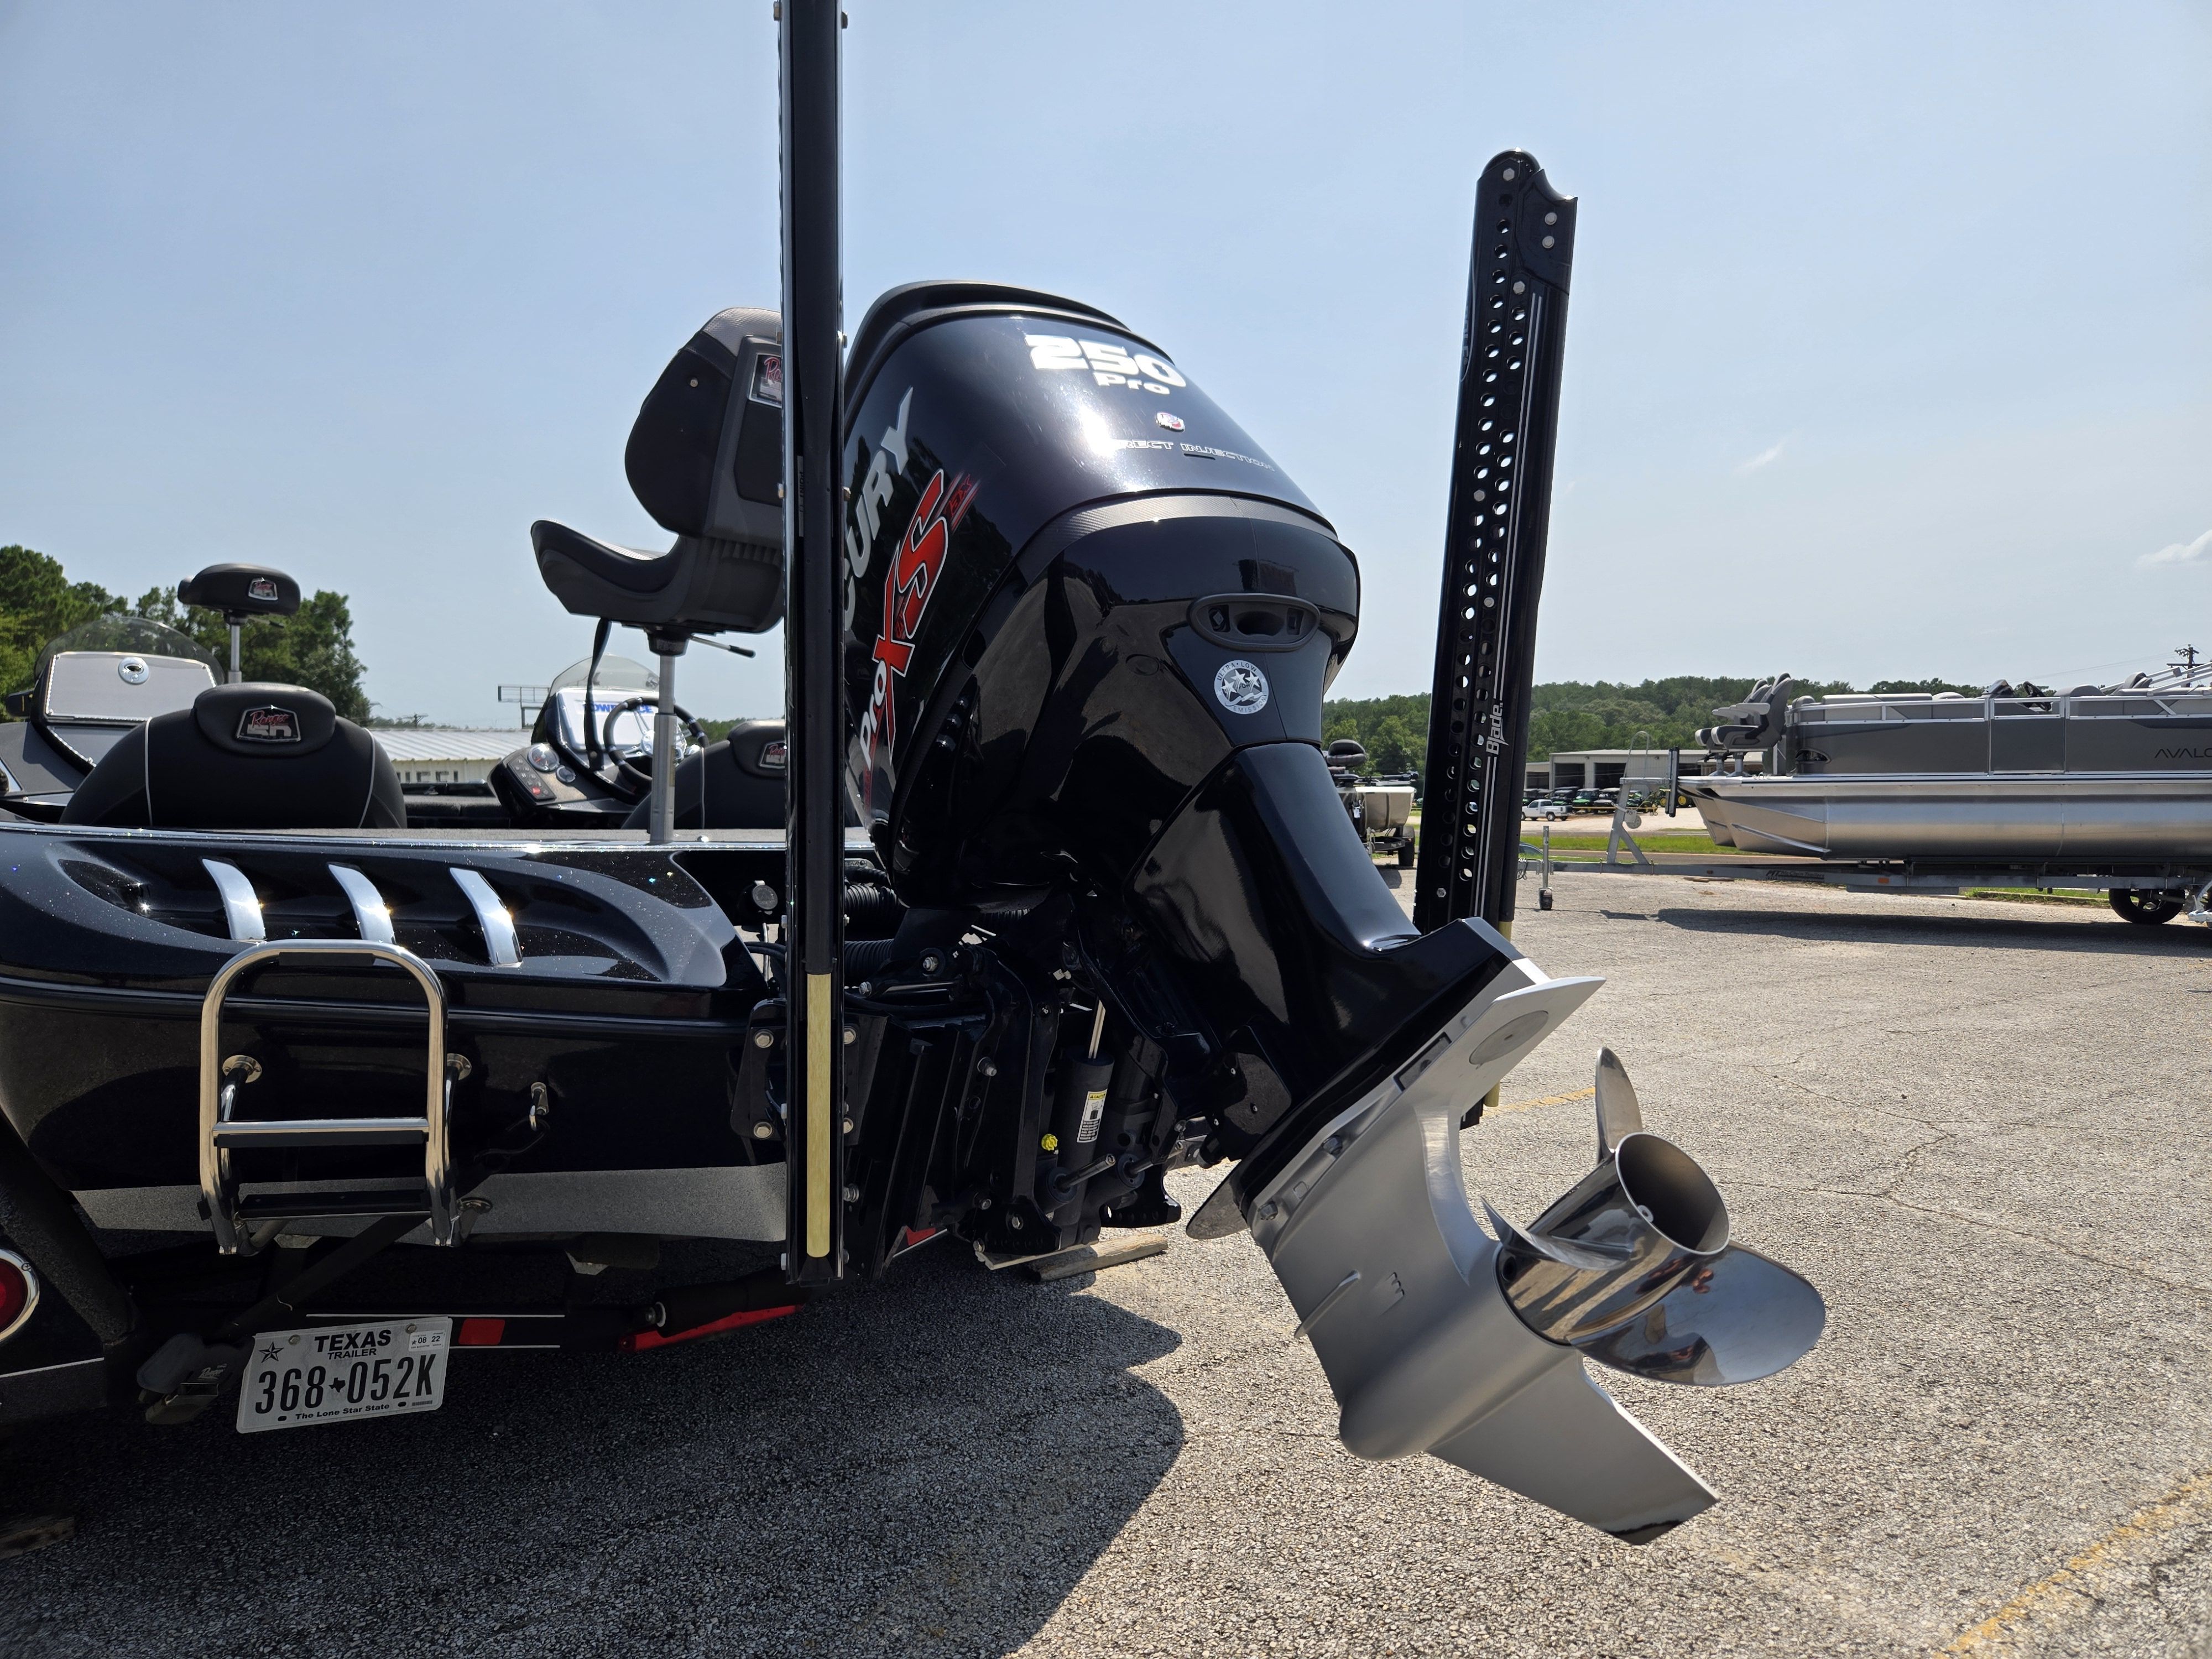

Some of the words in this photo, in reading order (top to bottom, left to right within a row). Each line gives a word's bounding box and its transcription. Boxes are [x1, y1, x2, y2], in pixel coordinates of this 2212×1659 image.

[1025, 334, 1186, 388] 250
[1093, 372, 1170, 394] Pro
[1180, 443, 1275, 472] INJECTION
[1217, 663, 1235, 681] ULTRA
[1241, 662, 1257, 672] LOW
[1233, 696, 1266, 713] EMISSION
[249, 710, 291, 728] Ranger
[1485, 705, 1509, 755] Blade
[314, 1329, 392, 1353] TEXAS
[327, 1348, 377, 1360] TRAILER
[254, 1365, 327, 1414] 368
[347, 1353, 436, 1404] 052K
[342, 1406, 363, 1414] Star
[365, 1403, 390, 1411] State
